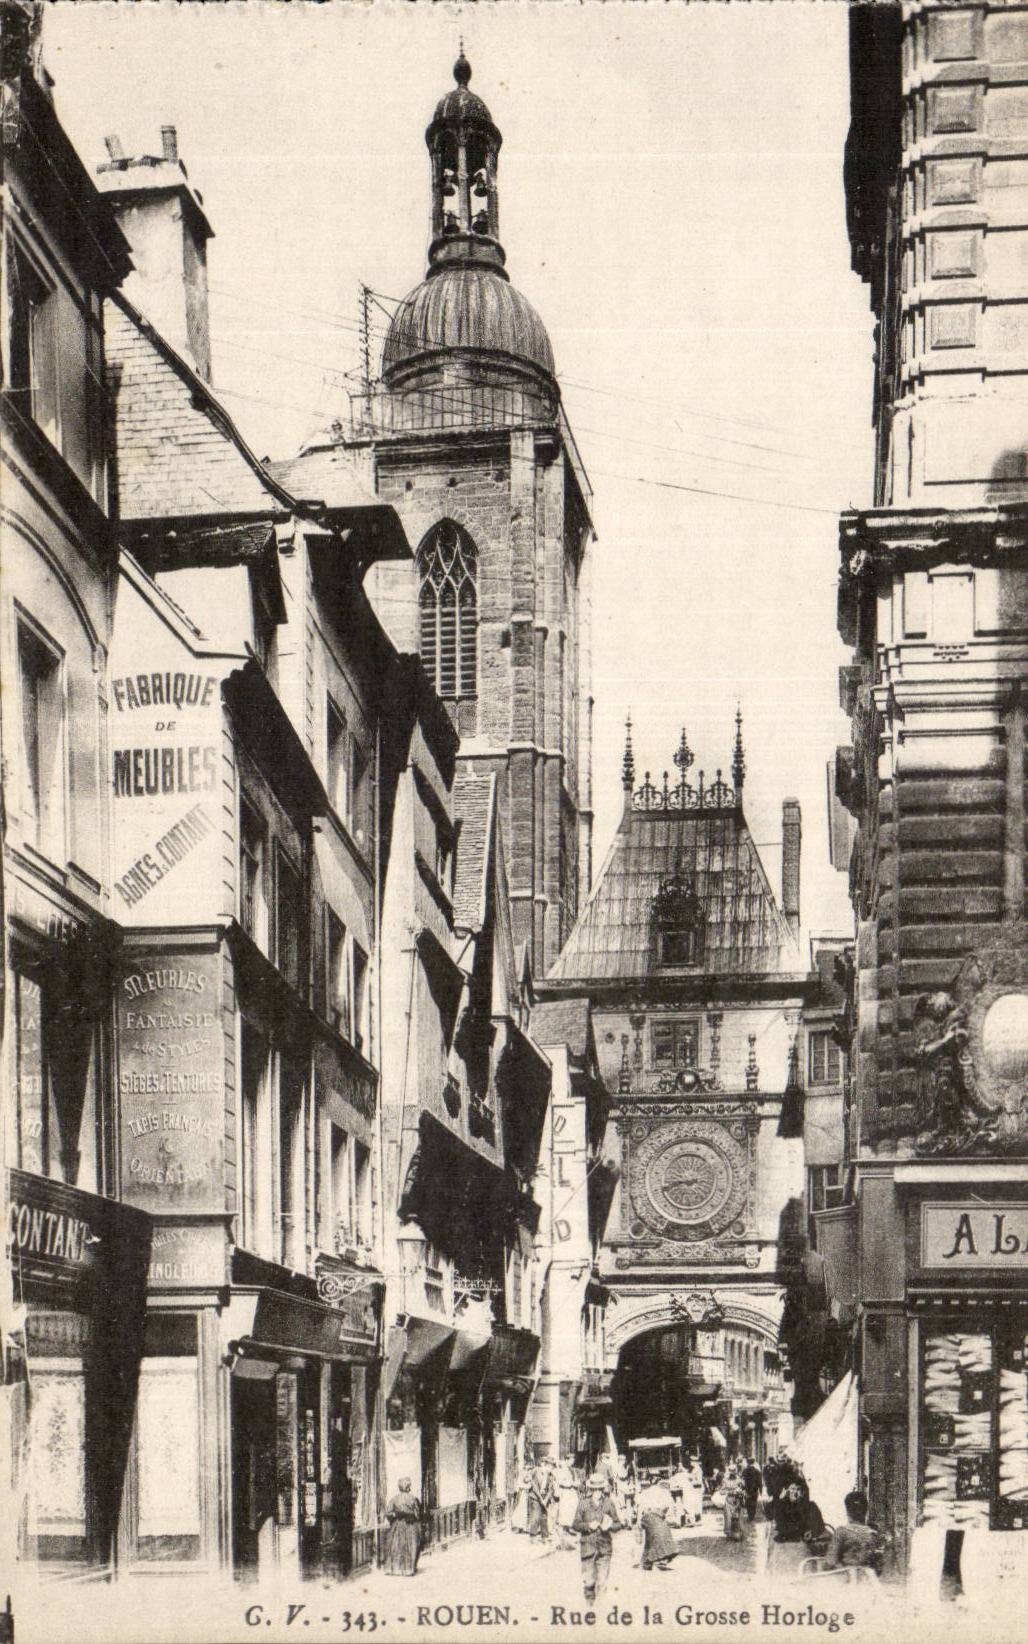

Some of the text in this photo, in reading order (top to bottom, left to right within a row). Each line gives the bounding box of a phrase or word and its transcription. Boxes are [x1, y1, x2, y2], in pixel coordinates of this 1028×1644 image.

[112, 672, 218, 712] FABRIQUE
[155, 721, 176, 731] DE
[113, 747, 217, 798] MEUBLES
[126, 1012, 216, 1029] FANTAISIE
[942, 1213, 1028, 1258] A L
